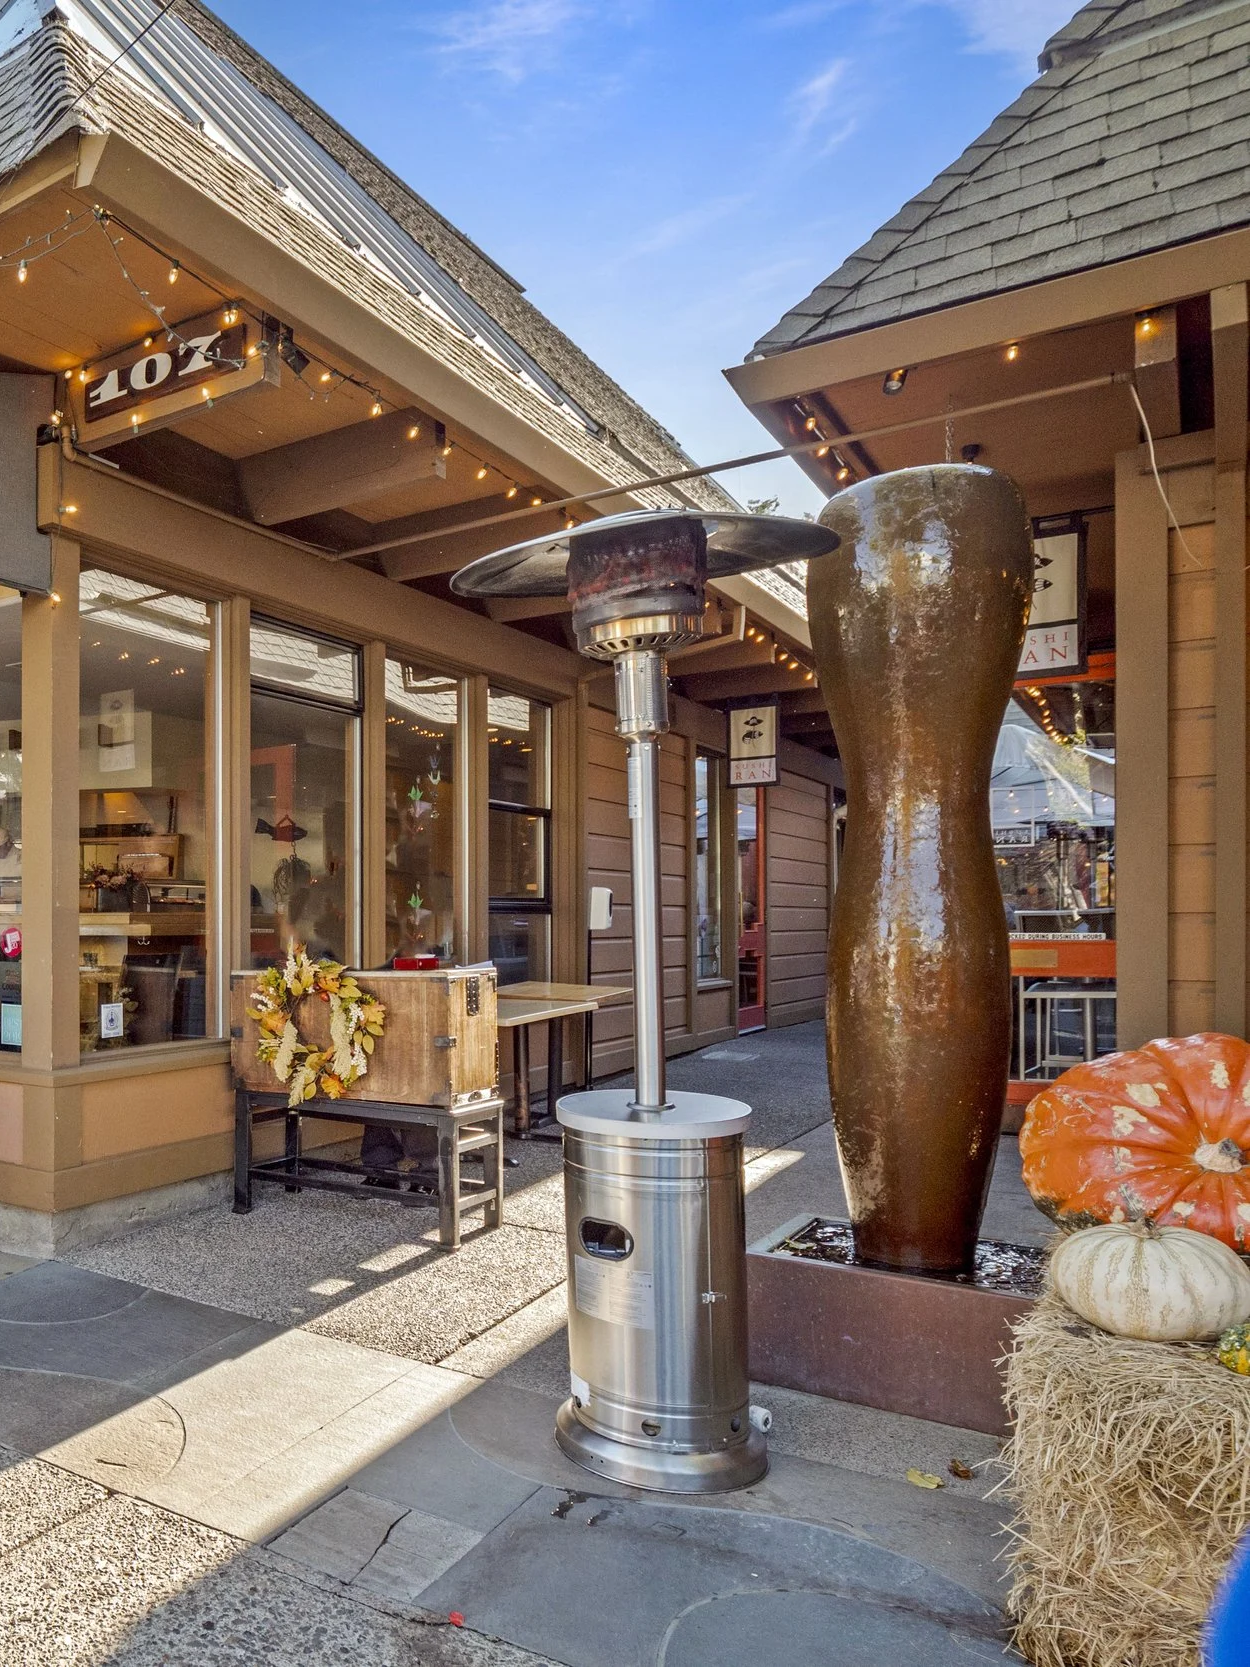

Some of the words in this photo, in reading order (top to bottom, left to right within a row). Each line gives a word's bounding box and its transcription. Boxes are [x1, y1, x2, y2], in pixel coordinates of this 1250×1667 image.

[89, 330, 222, 408] 107
[1029, 631, 1069, 645] SHI
[1024, 646, 1069, 665] AN
[735, 760, 772, 769] SUSHI
[735, 770, 771, 780] RAN
